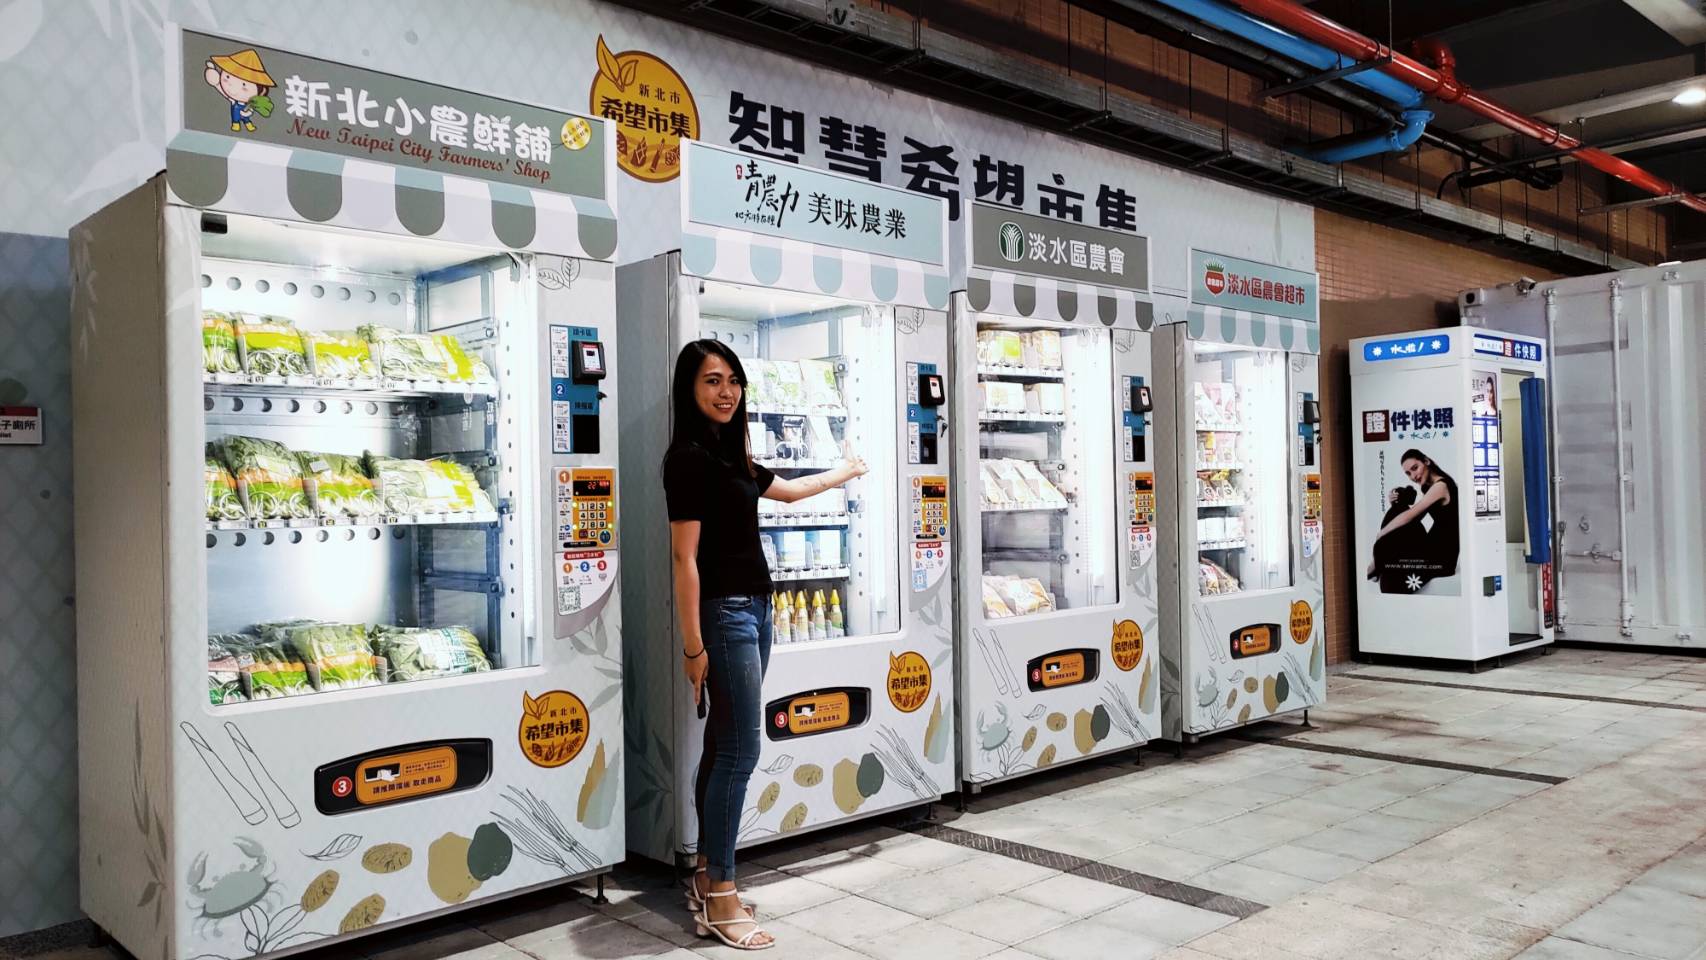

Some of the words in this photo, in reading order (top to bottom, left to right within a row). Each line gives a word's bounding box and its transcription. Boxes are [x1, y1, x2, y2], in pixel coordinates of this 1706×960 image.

[639, 83, 681, 104] 新北市
[600, 95, 691, 139] 希望市集
[287, 118, 331, 140] New
[336, 127, 395, 156] Taipei
[399, 139, 433, 164] City
[438, 145, 510, 172] Farmers'
[513, 160, 551, 182] Shop
[808, 191, 907, 239] 美味農業
[1028, 232, 1125, 276] 淡水區農會
[1227, 272, 1305, 306] 淡水區農會超市
[557, 384, 563, 394] 2
[910, 409, 915, 417] 2
[1365, 407, 1454, 434] 證件快照
[891, 674, 928, 690] 希望市集
[525, 718, 584, 741] 希望市集
[778, 714, 785, 725] 3
[338, 780, 347, 793] 3
